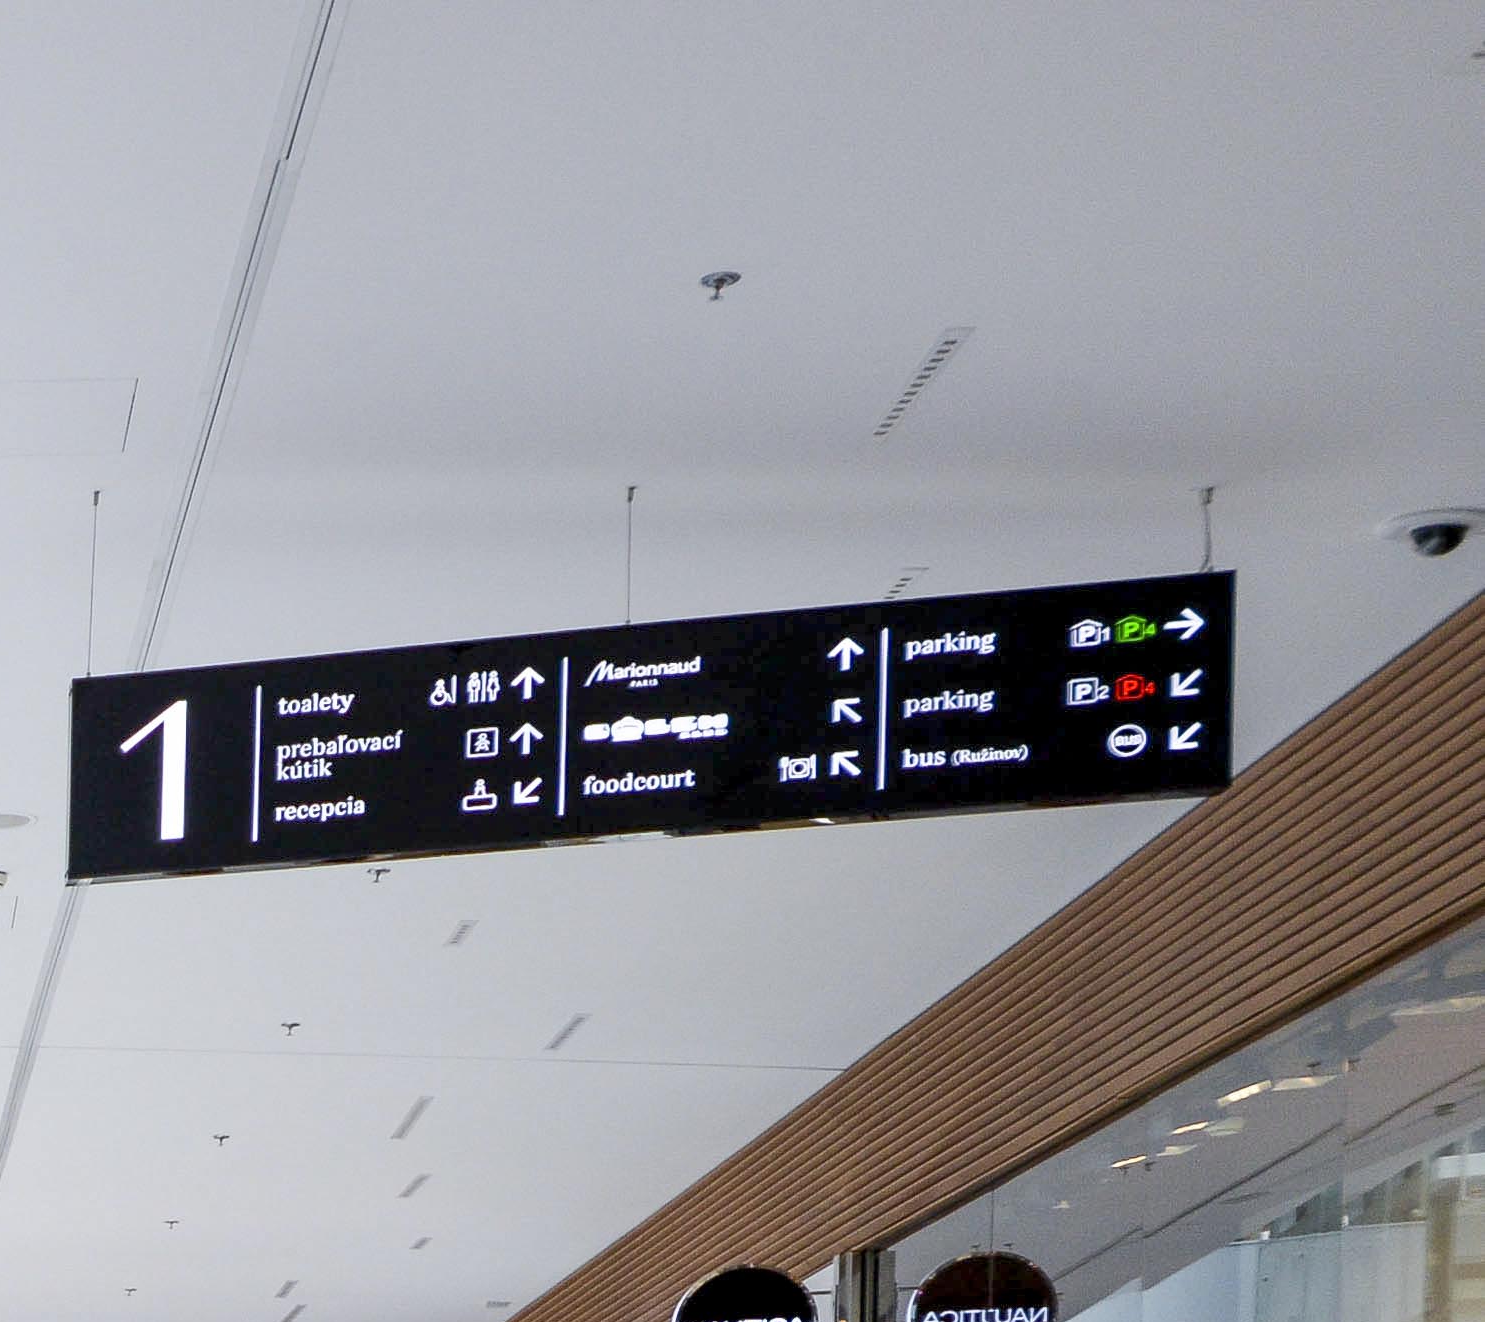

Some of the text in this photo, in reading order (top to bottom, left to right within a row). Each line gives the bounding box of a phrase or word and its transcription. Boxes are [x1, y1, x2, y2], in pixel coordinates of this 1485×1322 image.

[904, 631, 996, 661] parking
[583, 656, 701, 687] Marionnaud
[278, 692, 355, 715] toalety
[903, 689, 995, 718] parking
[276, 730, 402, 764] prebaľovací
[902, 747, 946, 769] bus
[950, 744, 1029, 766] (Ružinov)
[121, 700, 187, 840] 1
[276, 758, 333, 781] kútik
[582, 769, 695, 795] foodcourt
[275, 796, 365, 823] recepcia
